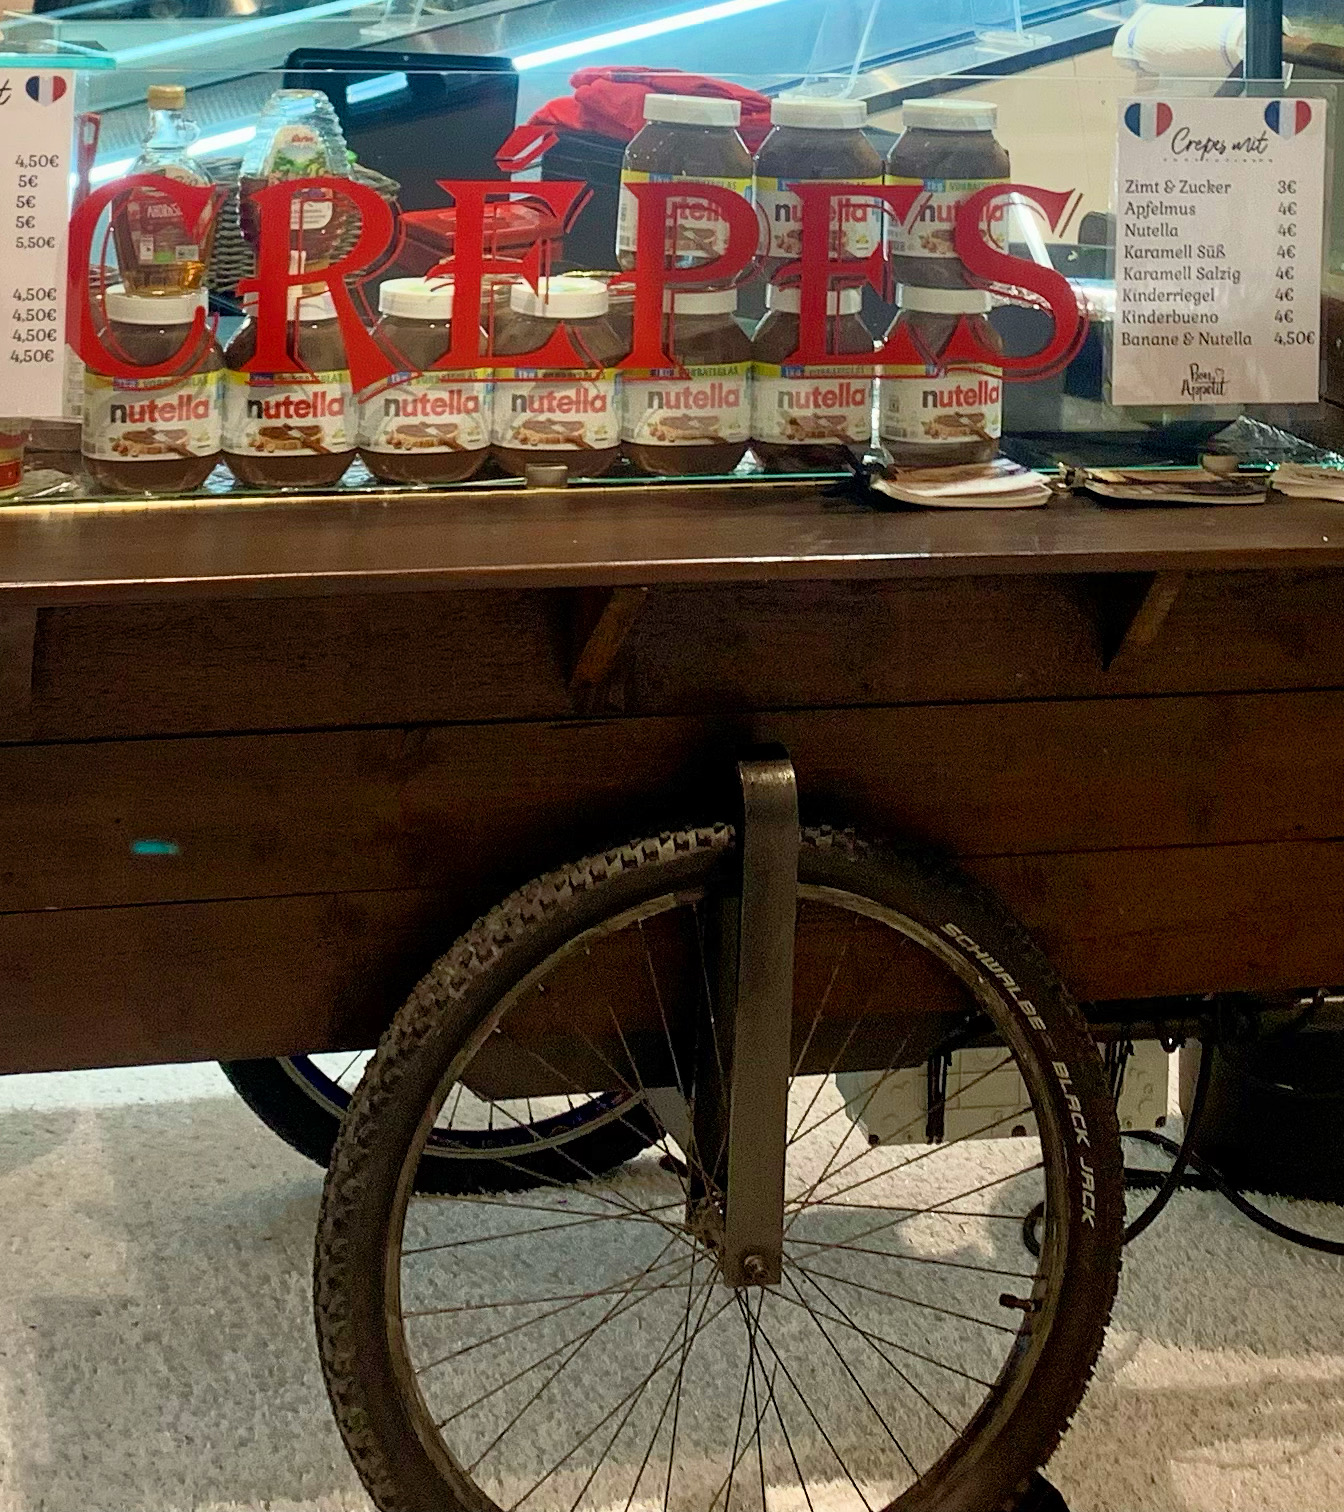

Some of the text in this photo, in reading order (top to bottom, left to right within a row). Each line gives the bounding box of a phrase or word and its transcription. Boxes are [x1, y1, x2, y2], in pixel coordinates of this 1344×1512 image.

[1171, 127, 1225, 161] Crepes
[15, 154, 59, 169] 4,50€
[18, 175, 38, 188] 5€
[1125, 179, 1297, 194] Zimt & Zucker 3€
[16, 195, 36, 208] 5€
[1124, 202, 1297, 218] Apfelmus 4€
[16, 216, 35, 228] 5€
[1124, 224, 1297, 237] Nutella 4€
[16, 237, 55, 249] 5,50€
[1124, 245, 1296, 259] Karamell Süß 4€
[1123, 266, 1294, 284] Karamell Salzig 4€
[13, 288, 57, 302] 4,50€
[1122, 288, 1294, 305] Kinderriegel 4€
[13, 308, 57, 323] 4,50€
[1122, 310, 1293, 324] Kinderbueno 4€
[13, 329, 57, 343] 4,50€
[1121, 331, 1315, 346] Banane & Nutella 4,50€
[10, 349, 54, 364] 4,50€
[511, 388, 606, 413] nutella
[647, 382, 740, 409] nutella
[778, 382, 866, 409] nutella
[922, 381, 1000, 409] nutella
[110, 394, 209, 424] nutella
[247, 391, 344, 419] nutella
[384, 390, 479, 417] nutella
[940, 923, 1095, 1229] SCHWALBE BLACK JACK
